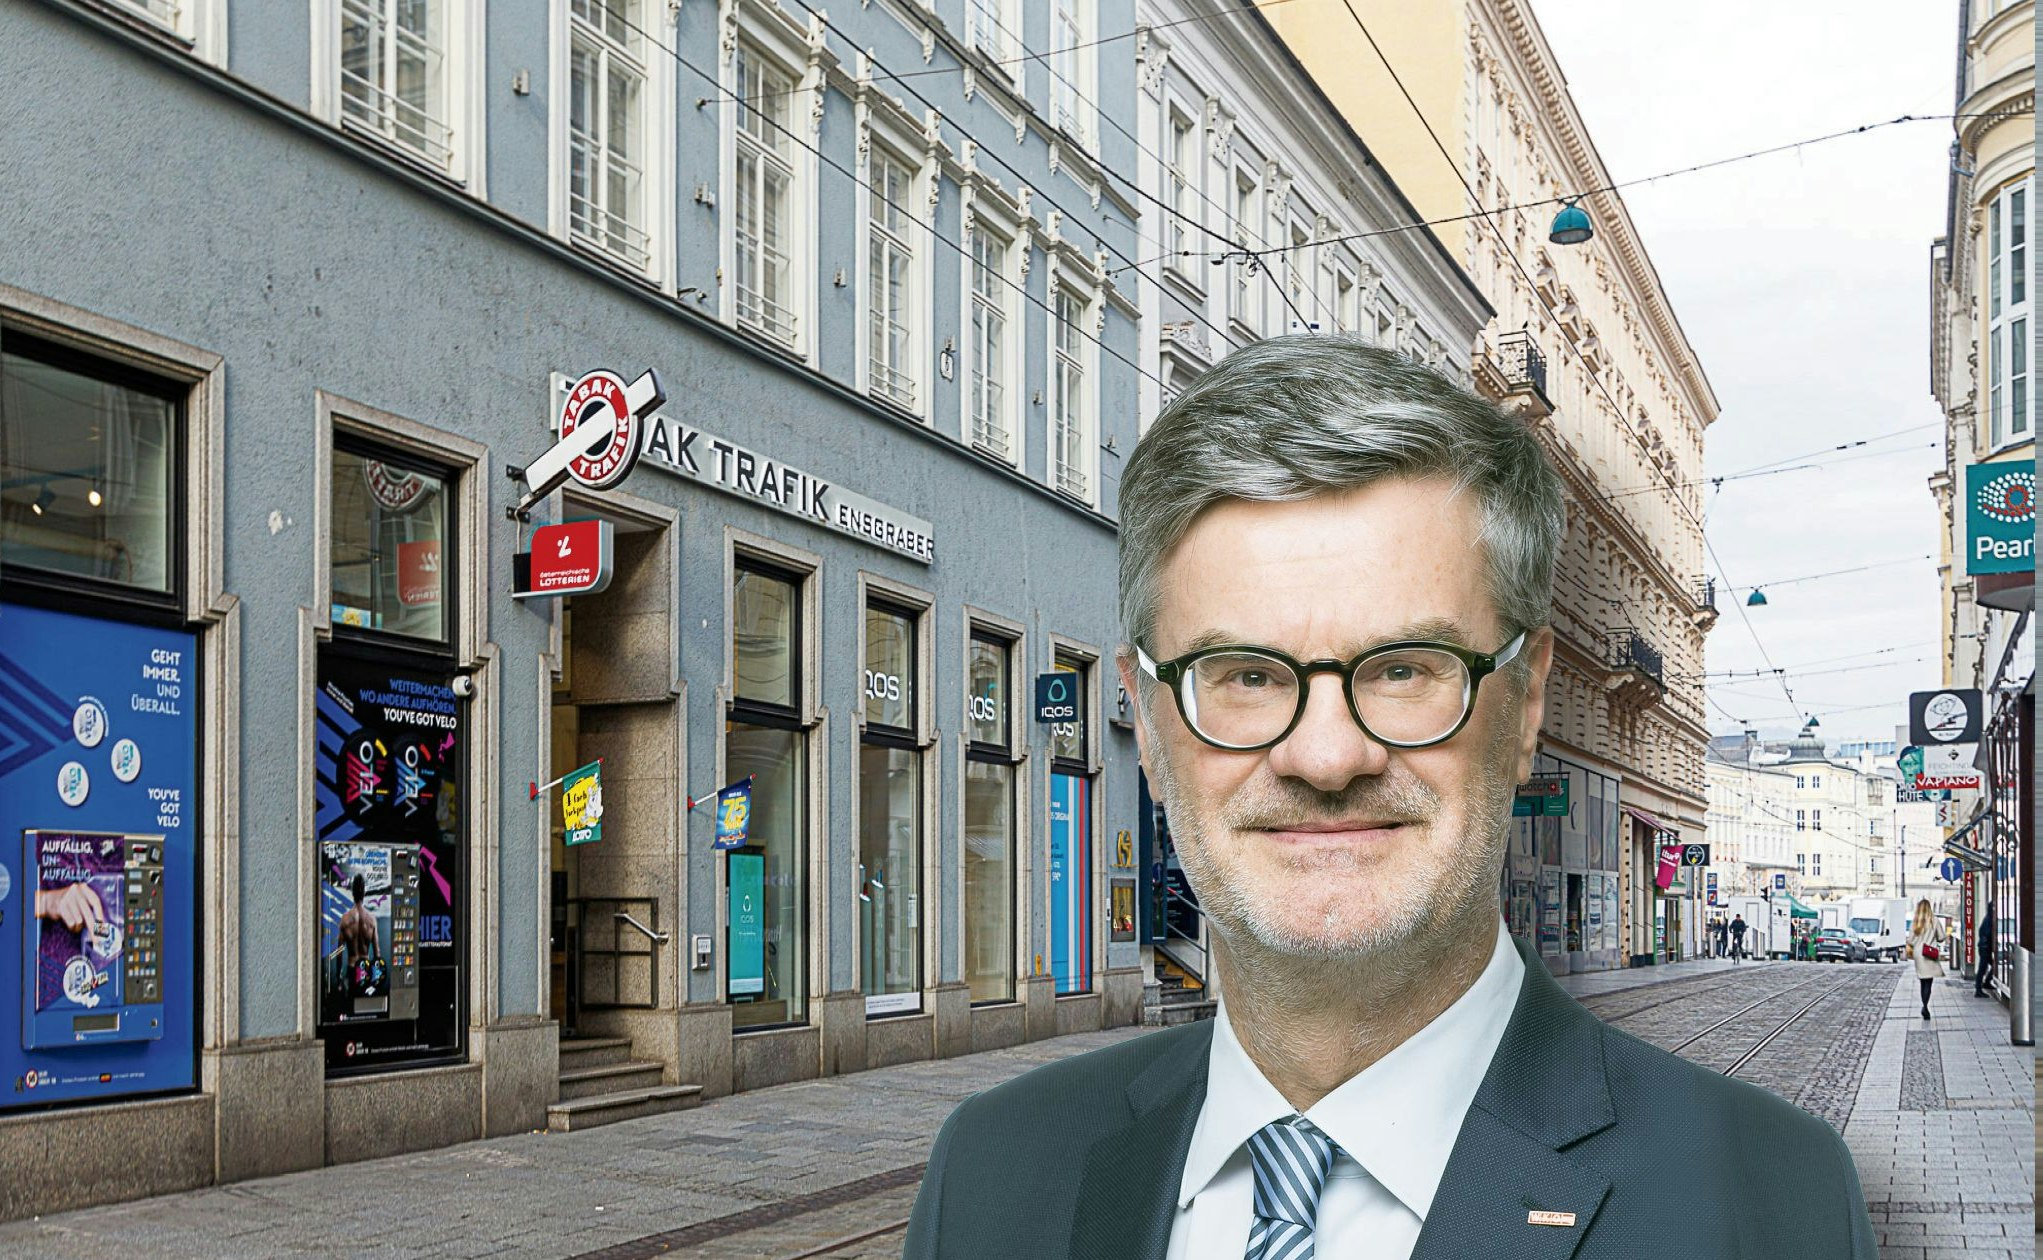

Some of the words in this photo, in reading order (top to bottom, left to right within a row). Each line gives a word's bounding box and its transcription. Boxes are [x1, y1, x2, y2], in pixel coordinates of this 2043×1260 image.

[564, 379, 615, 429] TABAK
[579, 416, 629, 478] TRAFIK
[710, 440, 829, 522] TRAFIK
[836, 503, 935, 560] ENSGRABER
[540, 575, 590, 586] LOTTERIEN
[151, 649, 181, 666] GEHT
[143, 664, 181, 682] IMMER.
[157, 684, 180, 698] UND
[360, 689, 376, 703] WO
[376, 694, 410, 707] ANDERE
[131, 694, 181, 715] ÜBERALL.
[1041, 706, 1074, 718] IQOS
[384, 707, 415, 724] YOU'VE
[416, 713, 433, 724] GOT
[435, 715, 457, 729] VELO
[360, 740, 373, 815] VELO
[405, 745, 418, 818] VELO
[1916, 775, 1979, 788] VAPIANO
[148, 788, 180, 801] YOU'VE
[160, 803, 180, 814] GOT
[157, 815, 180, 828] VELO
[42, 853, 61, 866] UN-
[1965, 870, 1973, 921] JANOUT
